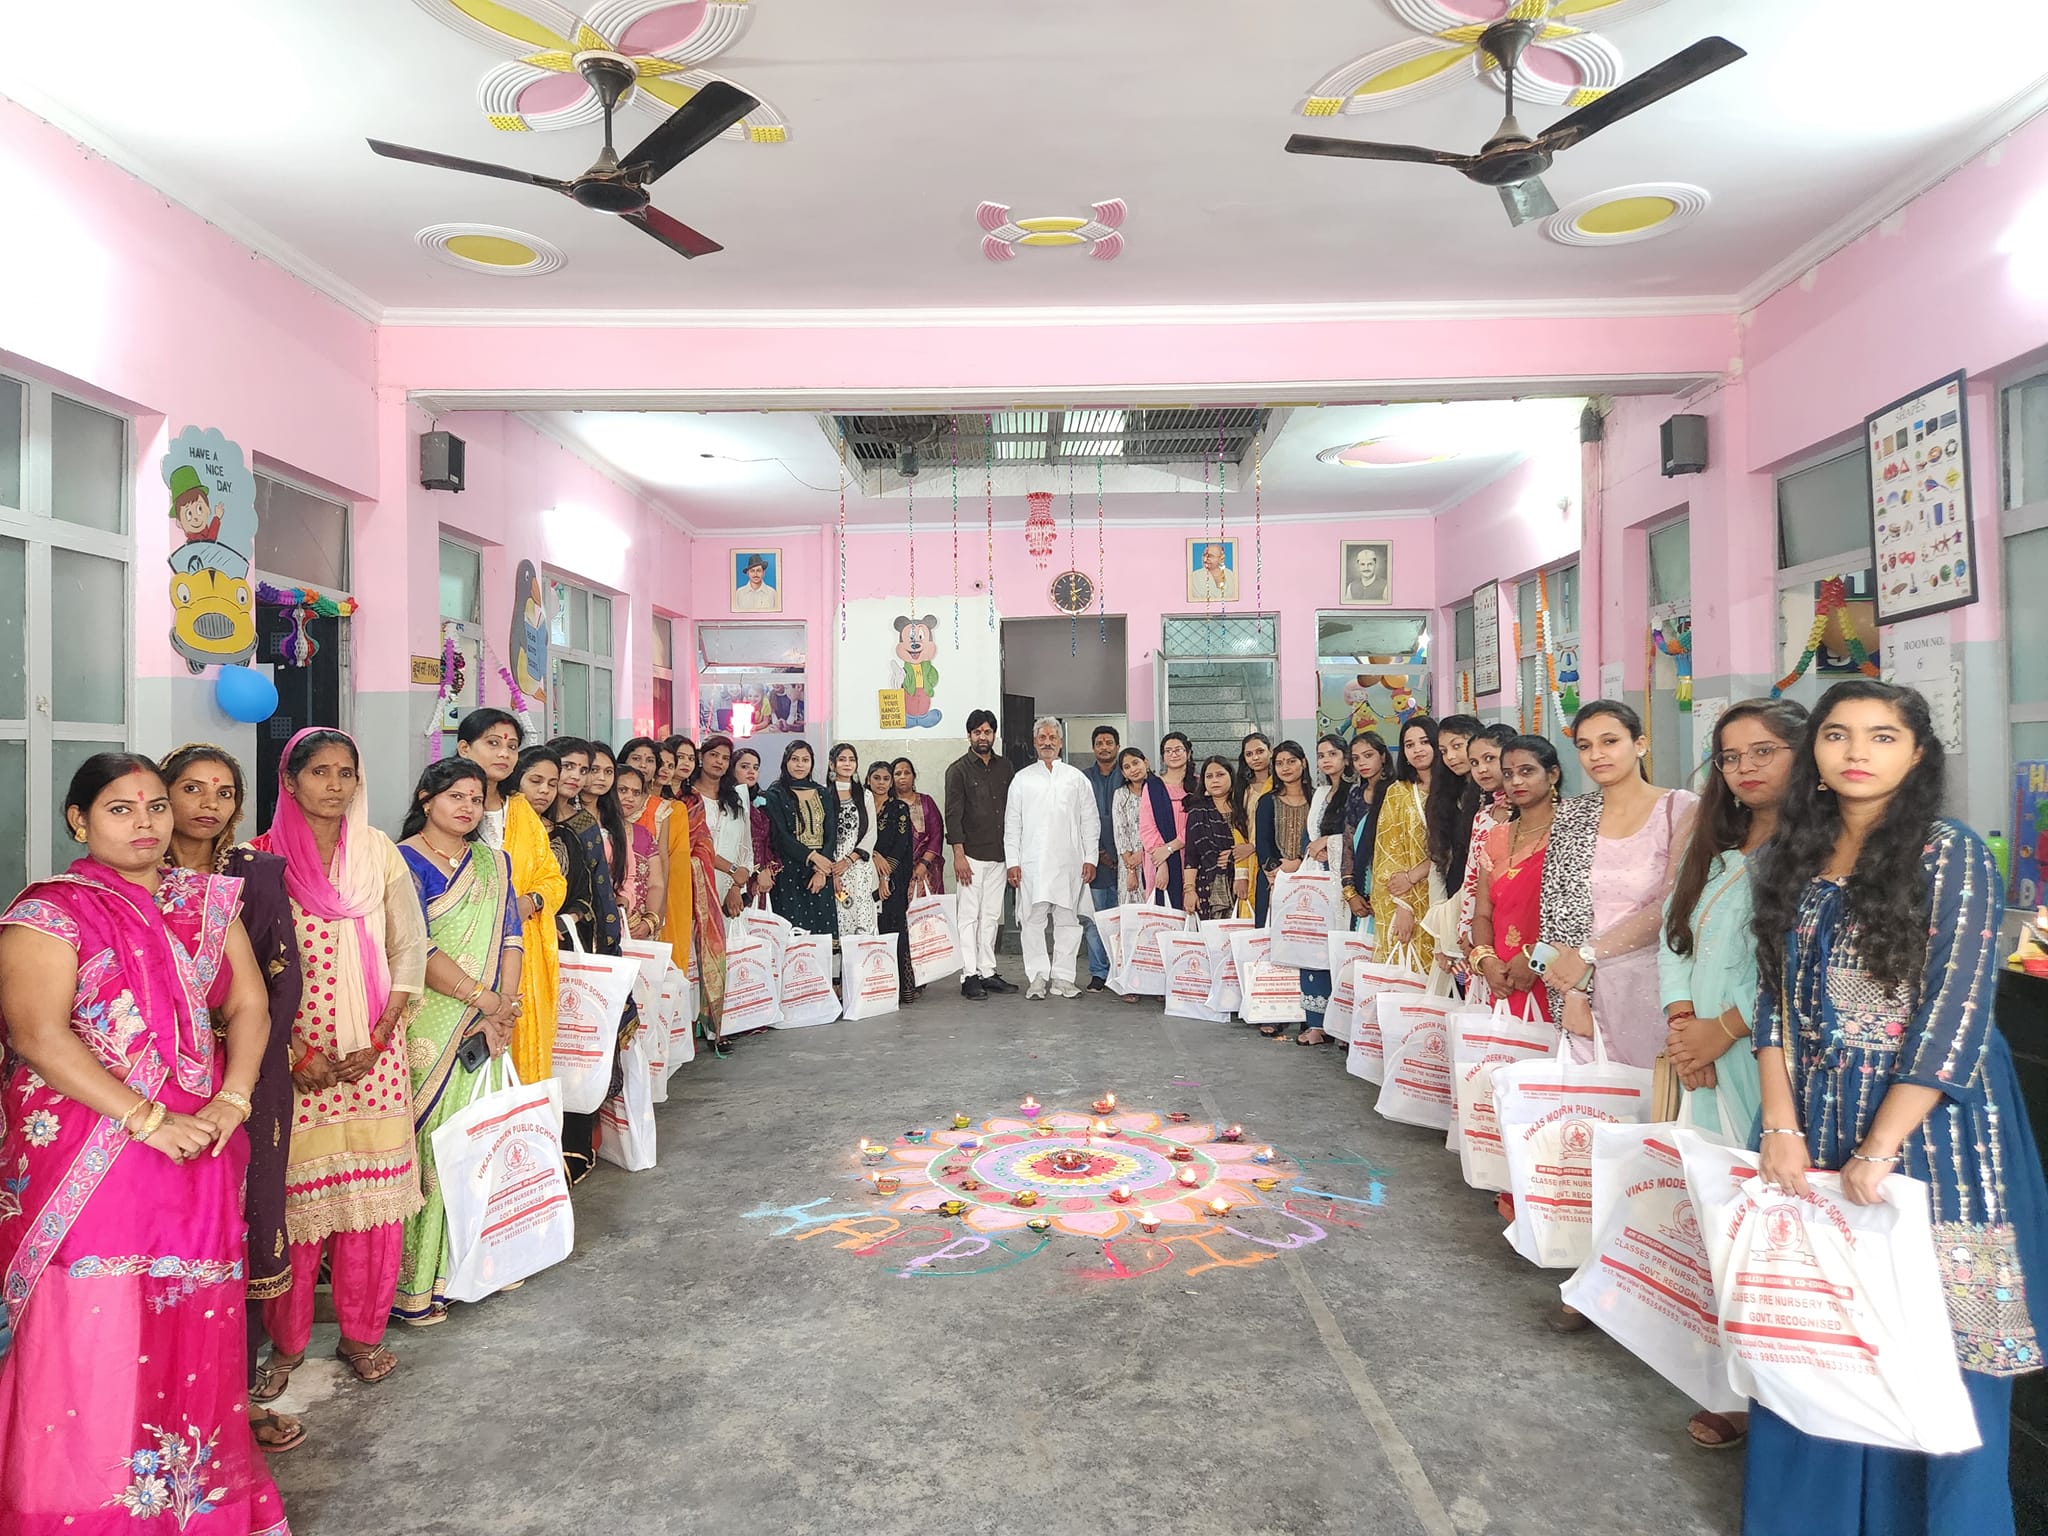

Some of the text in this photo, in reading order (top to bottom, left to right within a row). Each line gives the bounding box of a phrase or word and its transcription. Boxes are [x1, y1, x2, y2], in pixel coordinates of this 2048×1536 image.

[189, 447, 218, 461] HAVE A
[205, 463, 224, 477] NICE
[216, 480, 232, 493] DAY
[1903, 639, 1929, 651] ROOM
[589, 985, 609, 1010] SCHOOL
[1465, 1064, 1481, 1082] VIKAS
[1523, 1118, 1545, 1141] VIKAS
[1576, 1104, 1606, 1120] PUBLIC
[477, 1151, 493, 1179] VIKAS
[513, 1123, 534, 1134] PUBLIC
[1531, 1176, 1557, 1187] CLASSE
[1625, 1177, 1687, 1198] VIKAS MODE
[513, 1188, 537, 1202] NURSERY
[1726, 1203, 1746, 1241] VIKAS
[1825, 1204, 1858, 1251] SCHOOL
[1615, 1238, 1650, 1259] CLASSES
[1651, 1255, 1668, 1269] PRE
[1702, 1286, 1714, 1297] TO
[1639, 1263, 1662, 1280] GOVT.
[1758, 1293, 1773, 1306] PRE
[1774, 1295, 1822, 1309] NURSERY
[1827, 1301, 1838, 1312] TO
[1749, 1311, 1842, 1331] GOVT. RECOGNISED
